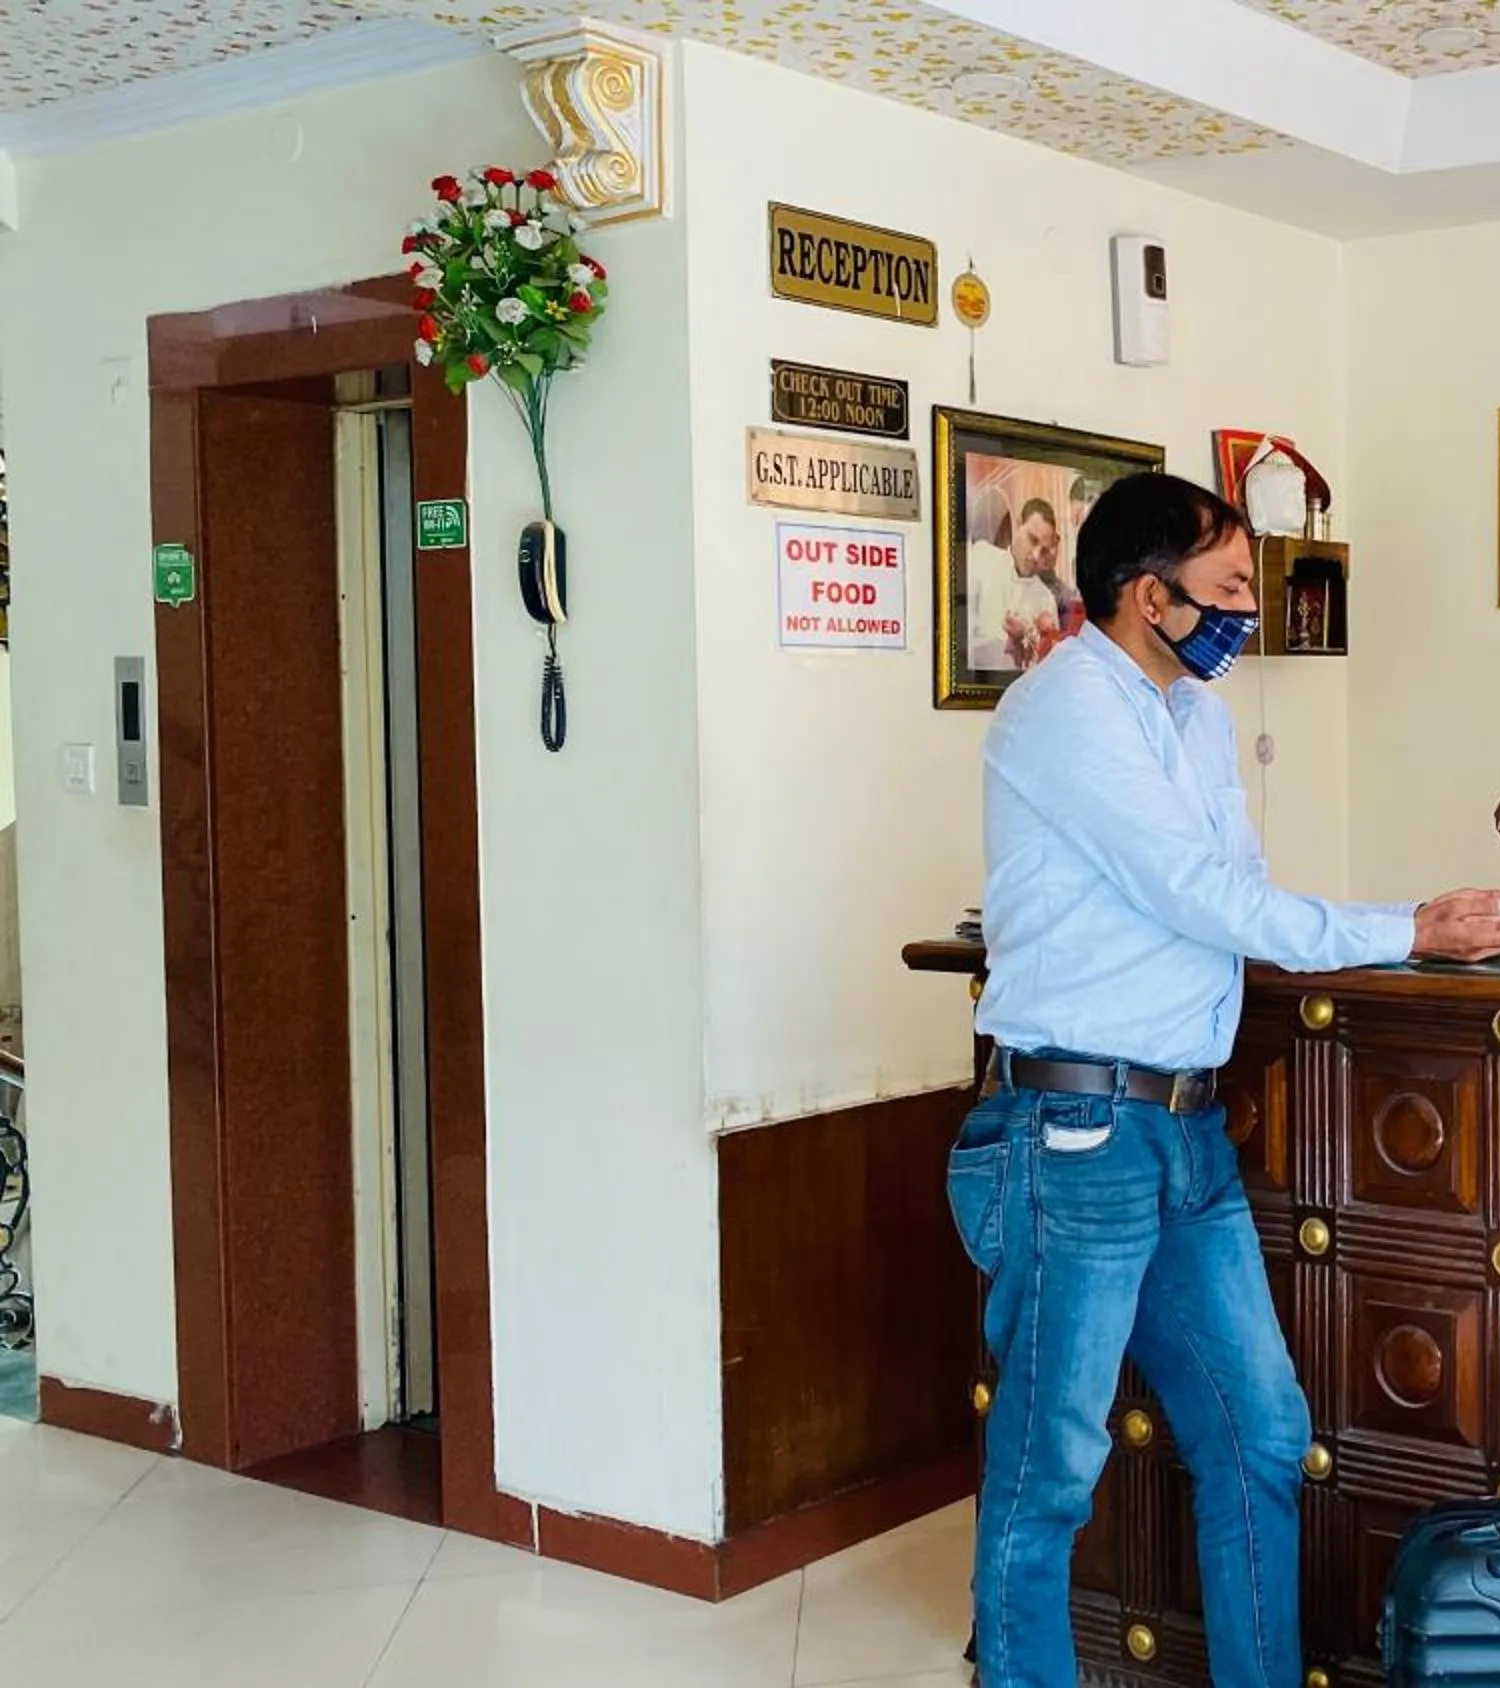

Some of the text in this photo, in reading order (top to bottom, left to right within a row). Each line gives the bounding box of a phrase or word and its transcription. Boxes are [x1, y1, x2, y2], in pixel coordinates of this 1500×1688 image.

[777, 227, 929, 304] RECEPTION
[780, 371, 899, 408] CHECK OUT TIME
[800, 396, 886, 428] 12:00 NOON
[755, 451, 913, 499] G.S.T. APPLICABLE
[786, 539, 898, 568] OUT SIDE
[811, 580, 877, 605] FOOD
[786, 615, 900, 635] NOT ALLOWED
